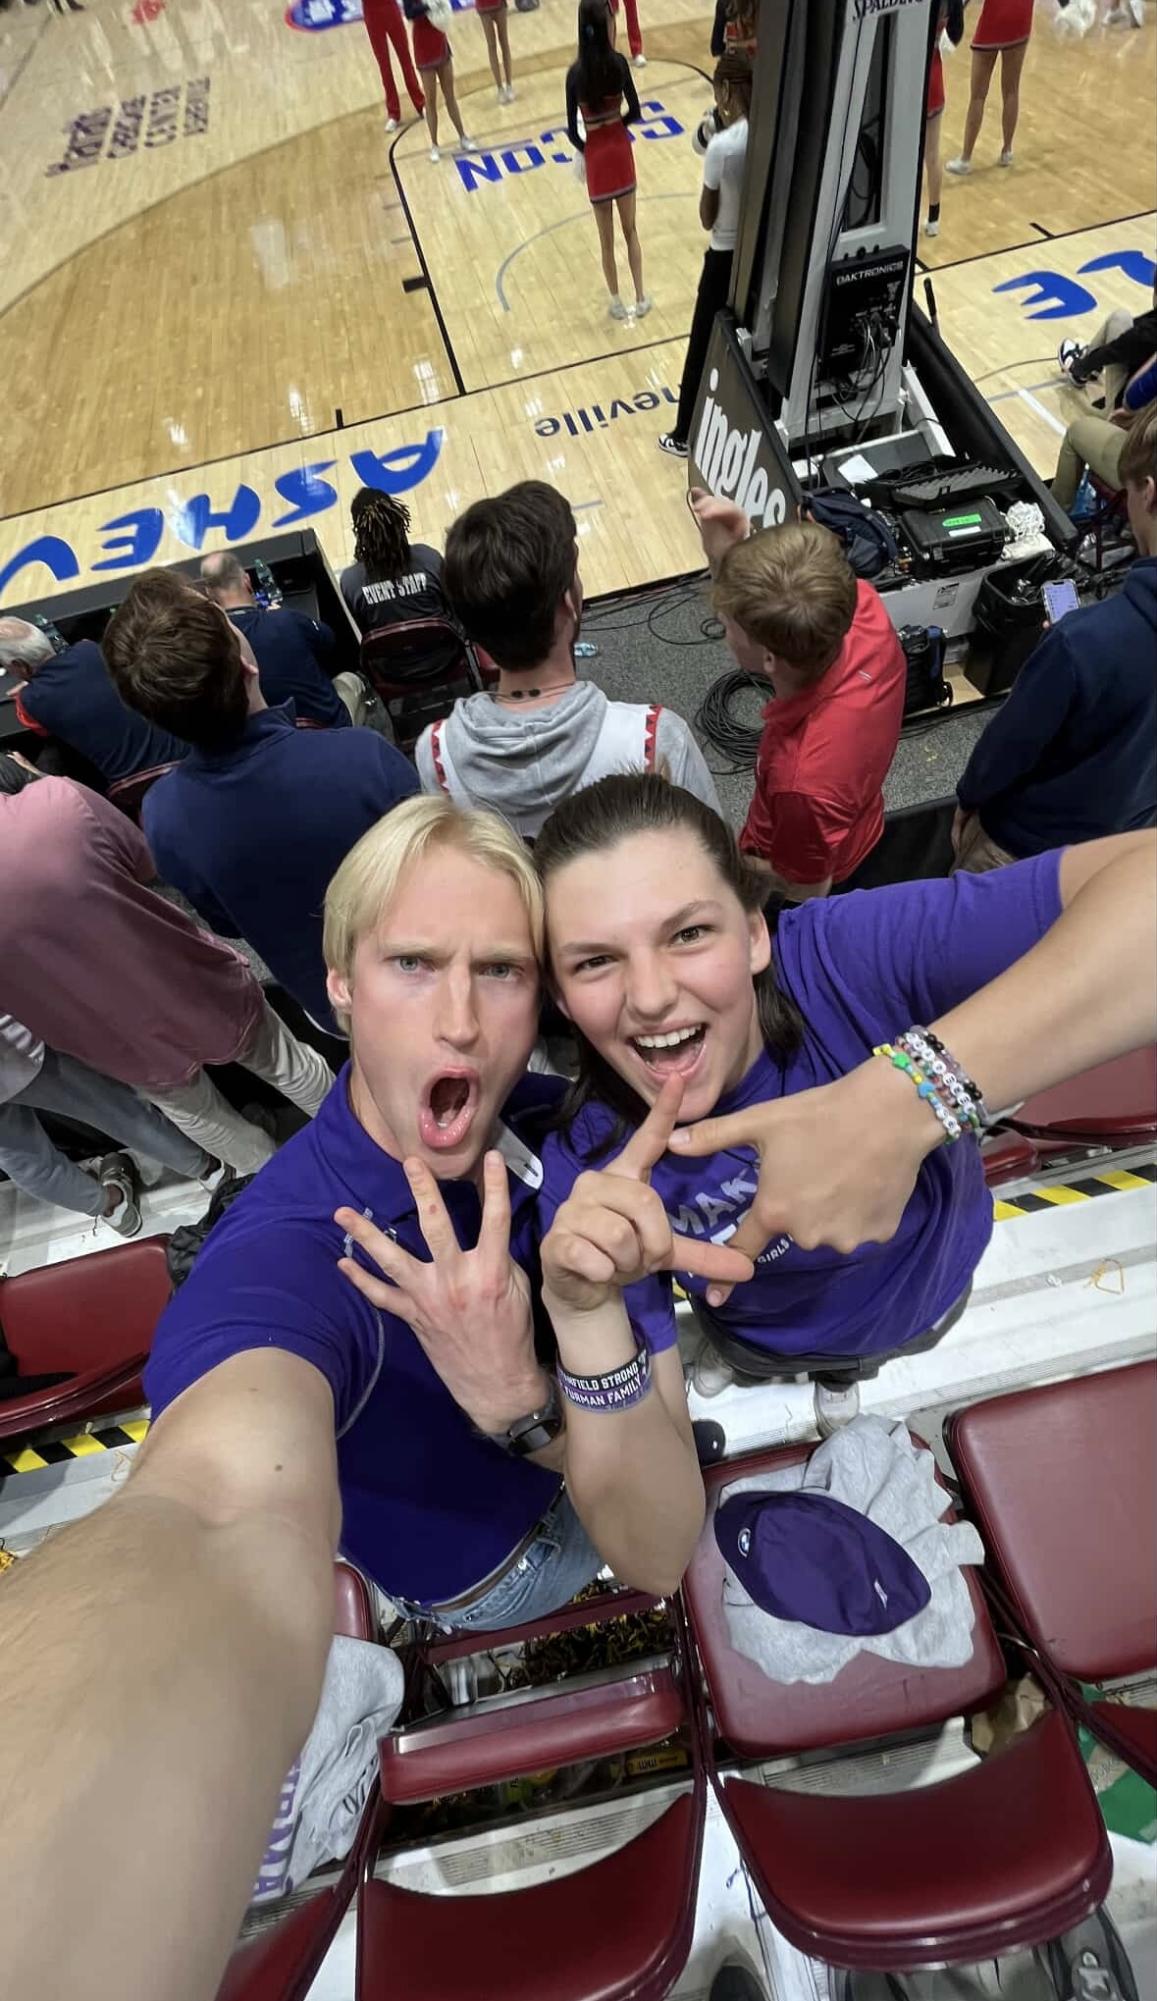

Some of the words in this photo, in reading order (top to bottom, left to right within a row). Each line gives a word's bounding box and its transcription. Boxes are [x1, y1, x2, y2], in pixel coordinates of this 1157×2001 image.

[454, 100, 685, 192] SCON
[361, 580, 396, 604] EVENT
[607, 1373, 641, 1404] FAMILY
